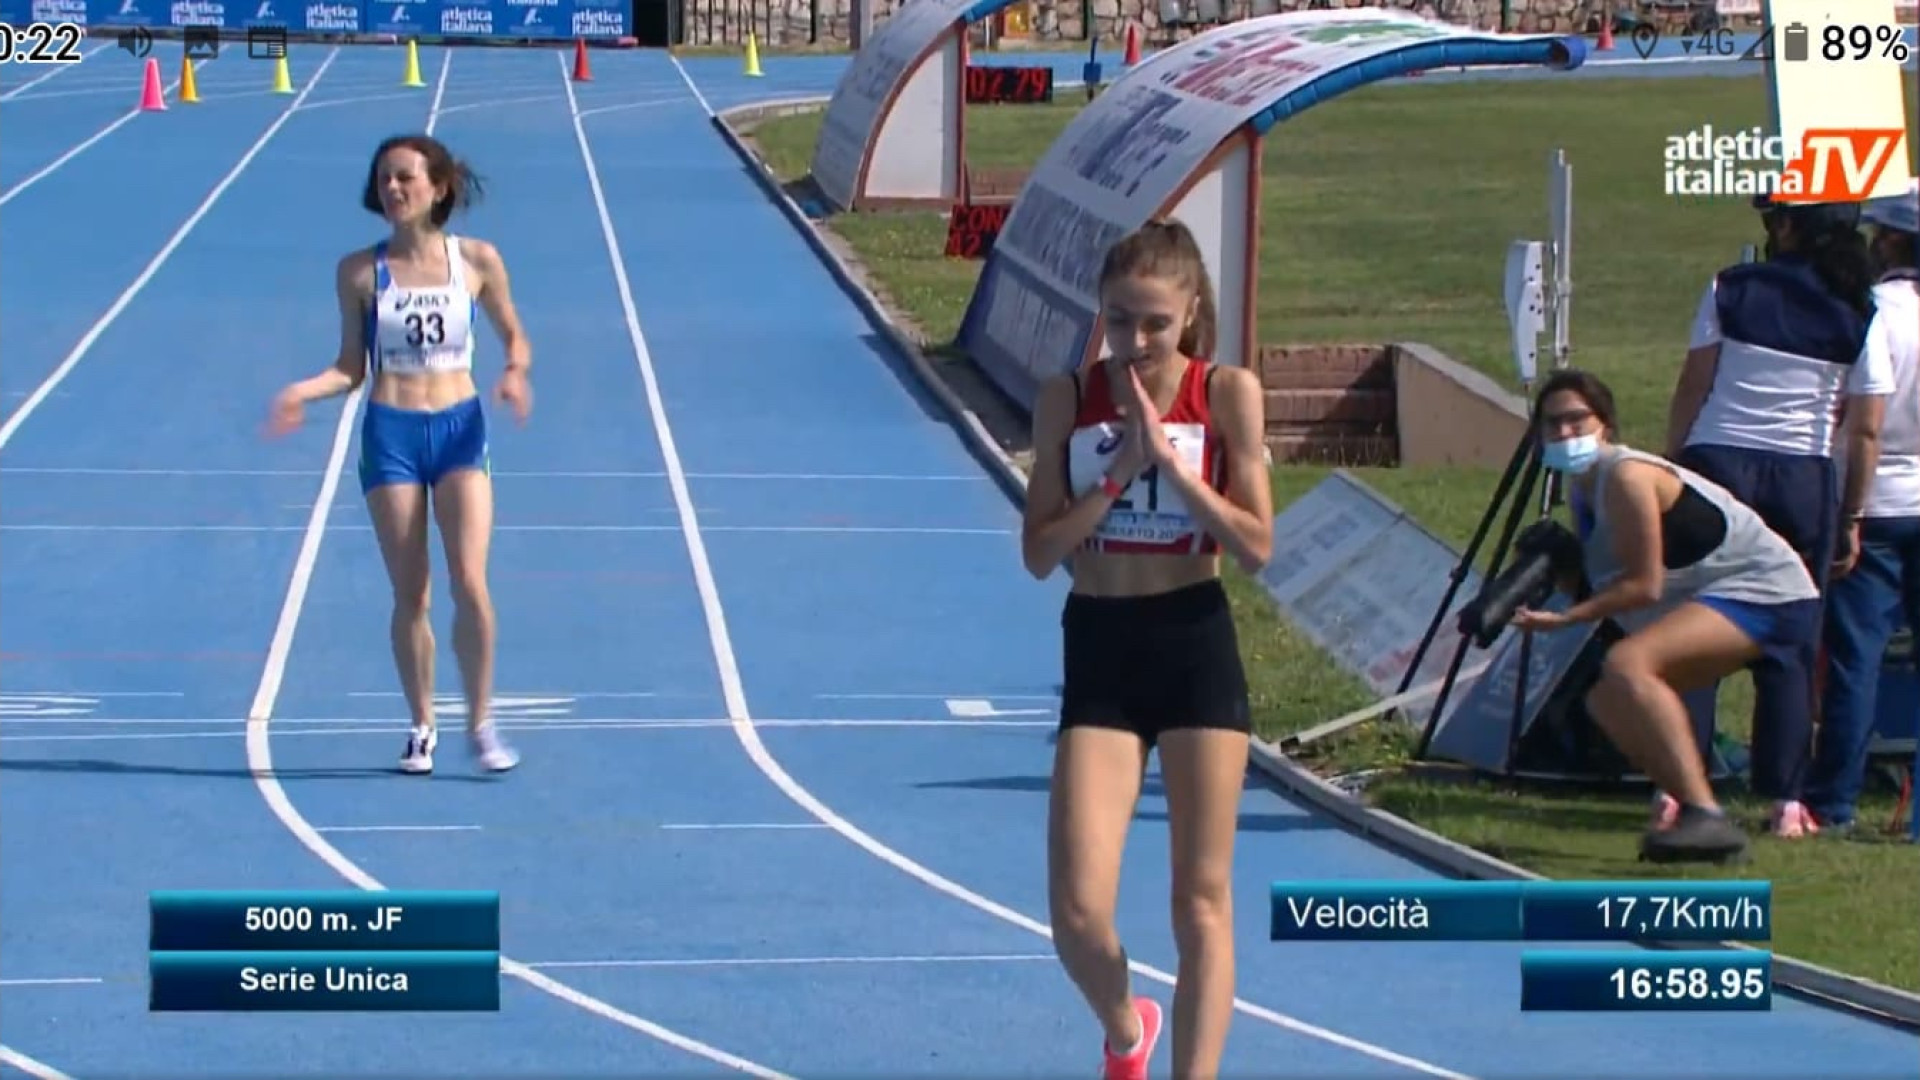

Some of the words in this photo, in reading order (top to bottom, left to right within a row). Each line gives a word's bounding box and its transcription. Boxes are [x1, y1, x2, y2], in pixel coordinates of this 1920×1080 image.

[305, 3, 358, 17] atletica
[441, 6, 492, 21] atletica
[572, 9, 622, 23] atletica
[305, 15, 358, 30] italiana
[441, 19, 492, 34] italiana
[572, 21, 622, 36] italiana
[405, 312, 445, 347] 33
